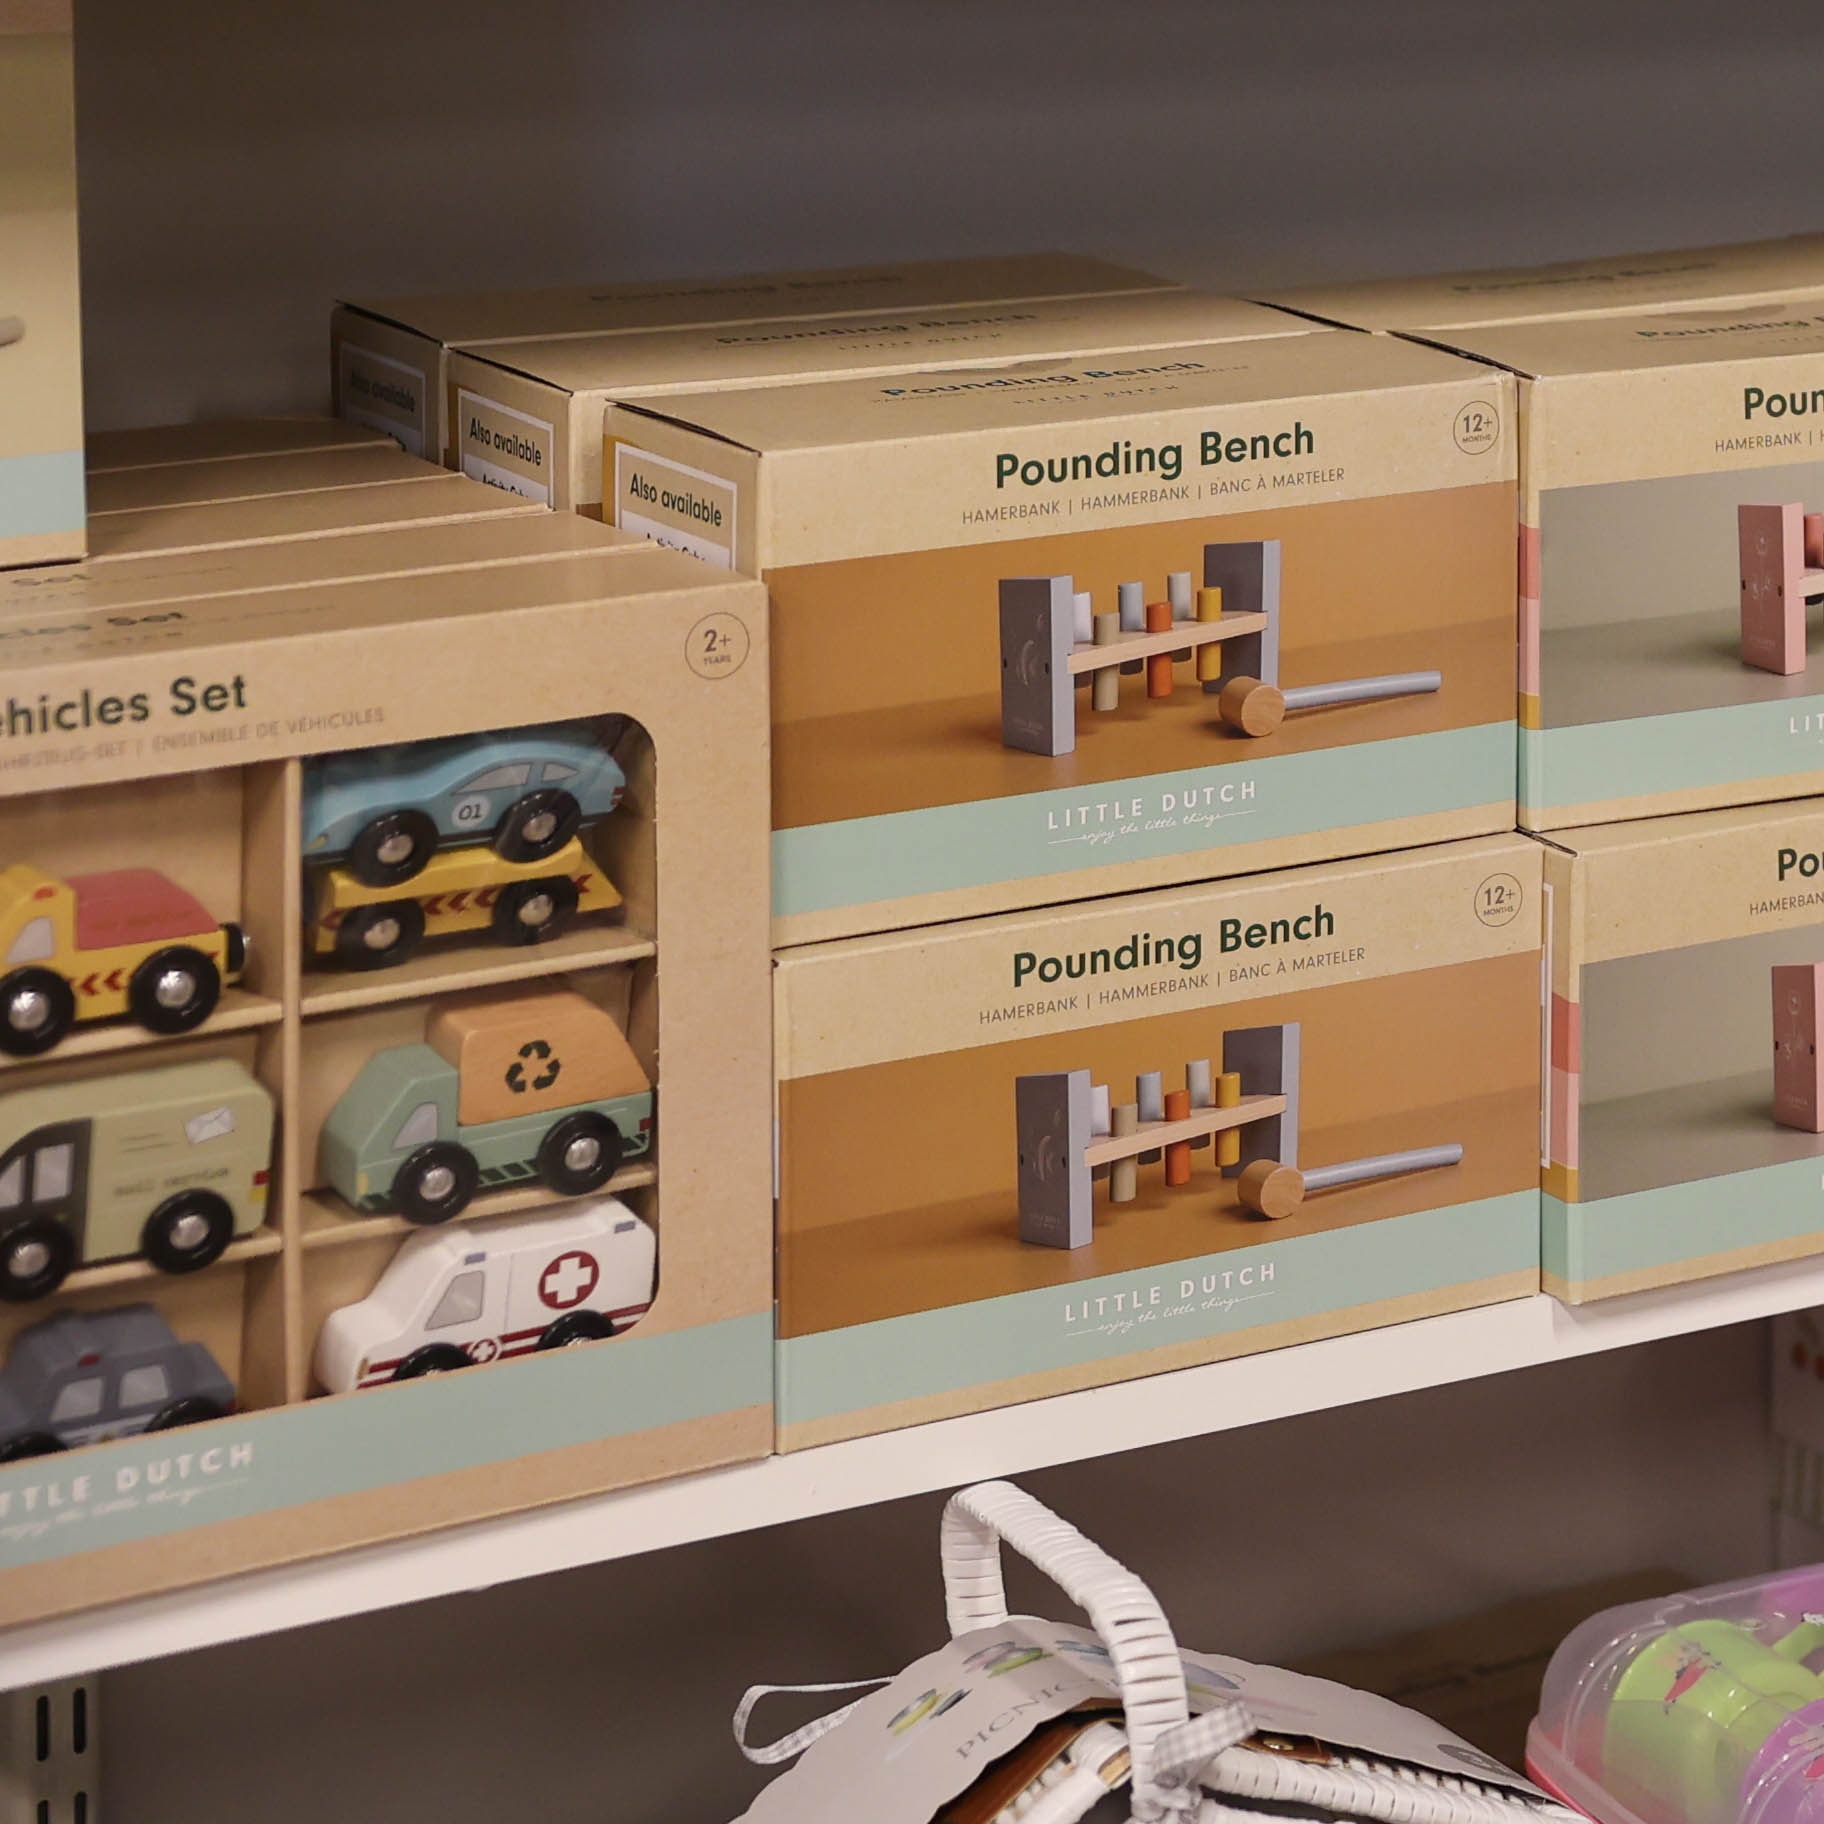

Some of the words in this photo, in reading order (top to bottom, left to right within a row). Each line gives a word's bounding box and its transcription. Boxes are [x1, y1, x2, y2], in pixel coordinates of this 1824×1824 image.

[469, 417, 491, 446] Also
[493, 433, 542, 467] available
[1462, 412, 1493, 434] 12+
[1715, 431, 1803, 453] HAMERBANK
[996, 440, 1183, 489] Pounding
[1200, 421, 1315, 467] Bench
[629, 472, 658, 503] Also
[661, 488, 722, 527] available
[961, 499, 1061, 525] HAMERBANK
[1080, 485, 1190, 513] HAMMERBANK
[1209, 478, 1252, 497] BANC
[1272, 467, 1346, 489] MARTELER
[703, 628, 732, 653] 2+
[0, 689, 150, 737] hicles
[170, 674, 248, 716] Set
[458, 804, 482, 821] 01
[1047, 797, 1143, 831] LITTLE
[1162, 780, 1256, 813] DUTCH
[1120, 823, 1139, 835] the
[1145, 817, 1178, 831] little
[1483, 885, 1516, 906] 12+
[1013, 933, 1201, 988] Pounding
[1219, 904, 1335, 954] Bench
[979, 995, 1079, 1025] HAMERBANK
[1099, 974, 1210, 1006] HAMMERBANK
[1228, 962, 1272, 984] BANC
[1292, 946, 1366, 973] MARTELER
[1065, 1286, 1161, 1323] LITTLE
[1180, 1263, 1276, 1299] DUTCH
[116, 1441, 254, 1494] DUTCH
